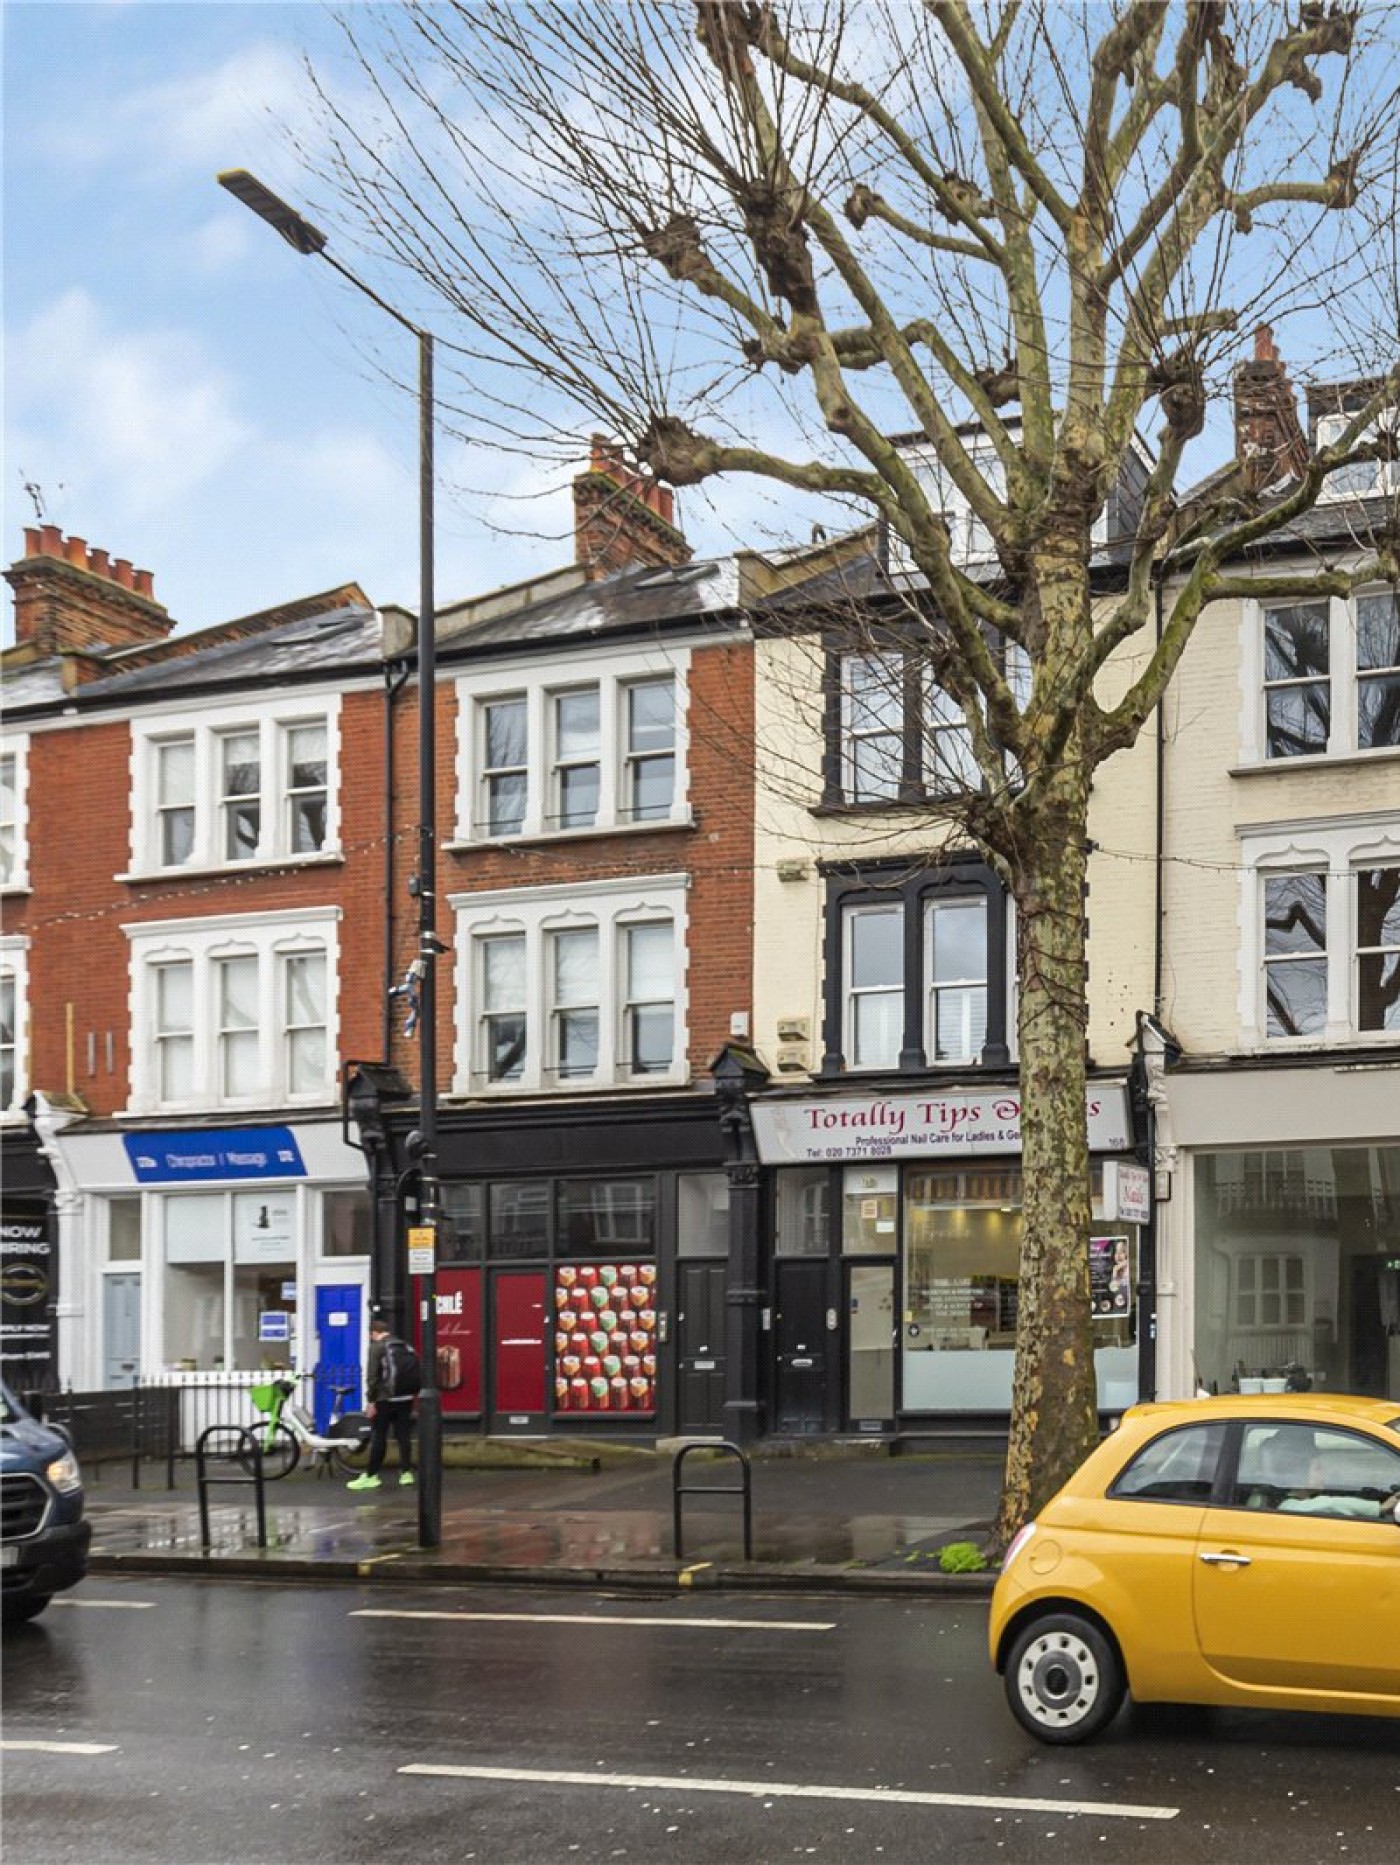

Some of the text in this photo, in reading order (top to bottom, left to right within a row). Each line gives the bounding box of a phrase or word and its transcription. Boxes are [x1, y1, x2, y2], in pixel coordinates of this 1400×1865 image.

[804, 1102, 905, 1135] Totally
[917, 1102, 981, 1133] Tips
[856, 1134, 908, 1147] Professional
[910, 1132, 928, 1144] Nail
[929, 1132, 949, 1144] Care
[951, 1131, 964, 1142] for
[965, 1130, 994, 1142] Ladies
[997, 1129, 1004, 1140] &
[825, 1146, 843, 1158] 020
